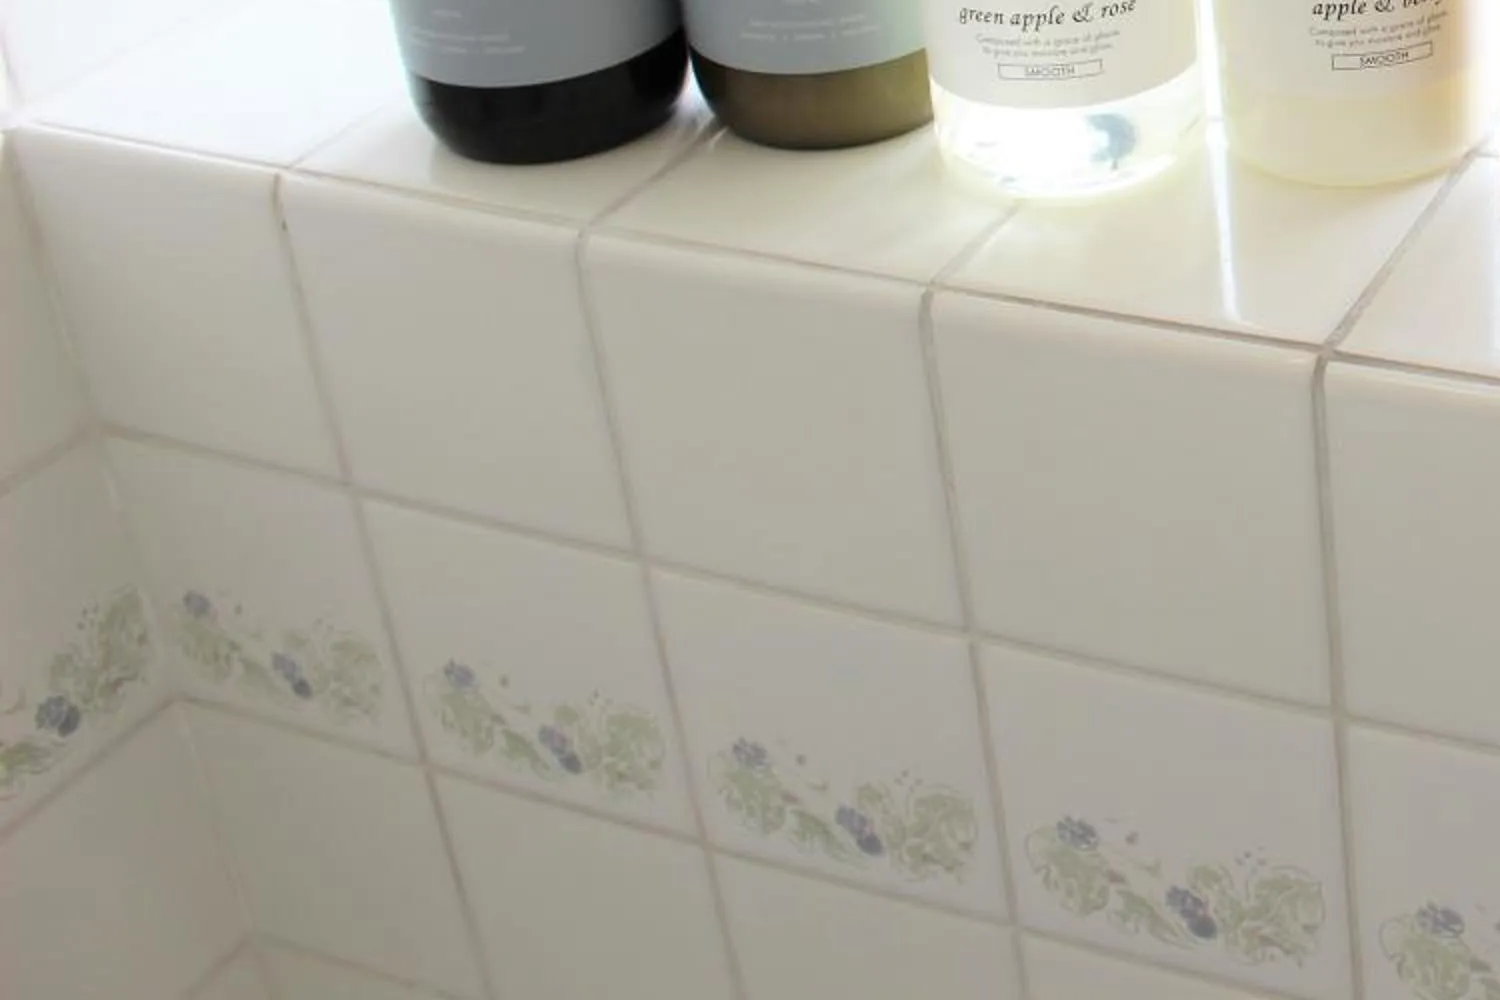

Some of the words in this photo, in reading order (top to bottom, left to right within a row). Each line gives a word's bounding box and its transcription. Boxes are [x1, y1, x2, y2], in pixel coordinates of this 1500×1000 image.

[958, 5, 1004, 25] green
[1008, 3, 1066, 33] apple
[1072, 1, 1095, 23] &
